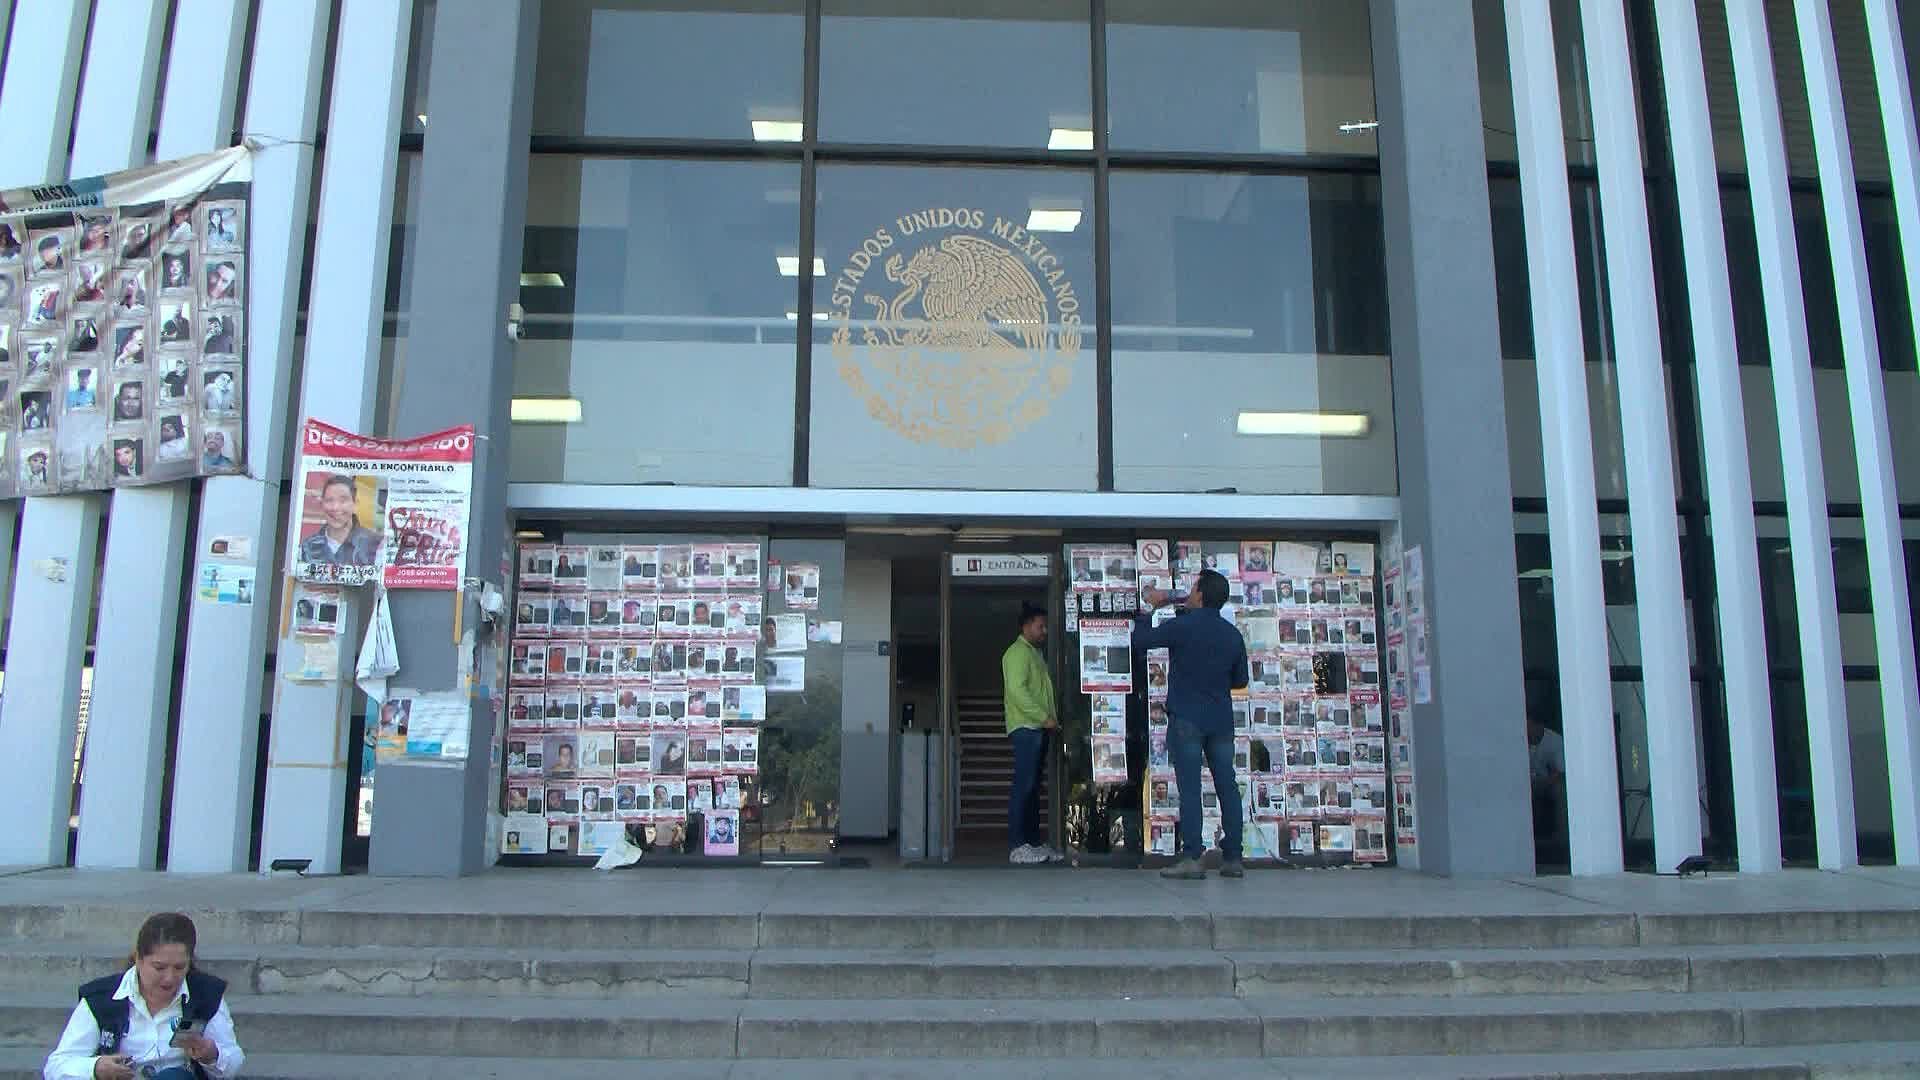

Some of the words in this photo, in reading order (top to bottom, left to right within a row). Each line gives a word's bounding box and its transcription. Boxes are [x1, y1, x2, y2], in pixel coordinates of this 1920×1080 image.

[32, 184, 79, 202] HASTA
[832, 229, 893, 320] ESTADOS
[897, 208, 984, 235] UNIDOS
[992, 217, 1081, 327] MEXICANOS
[308, 427, 469, 453] DESAPARECIDO
[381, 463, 454, 473] ENCONTRARLO
